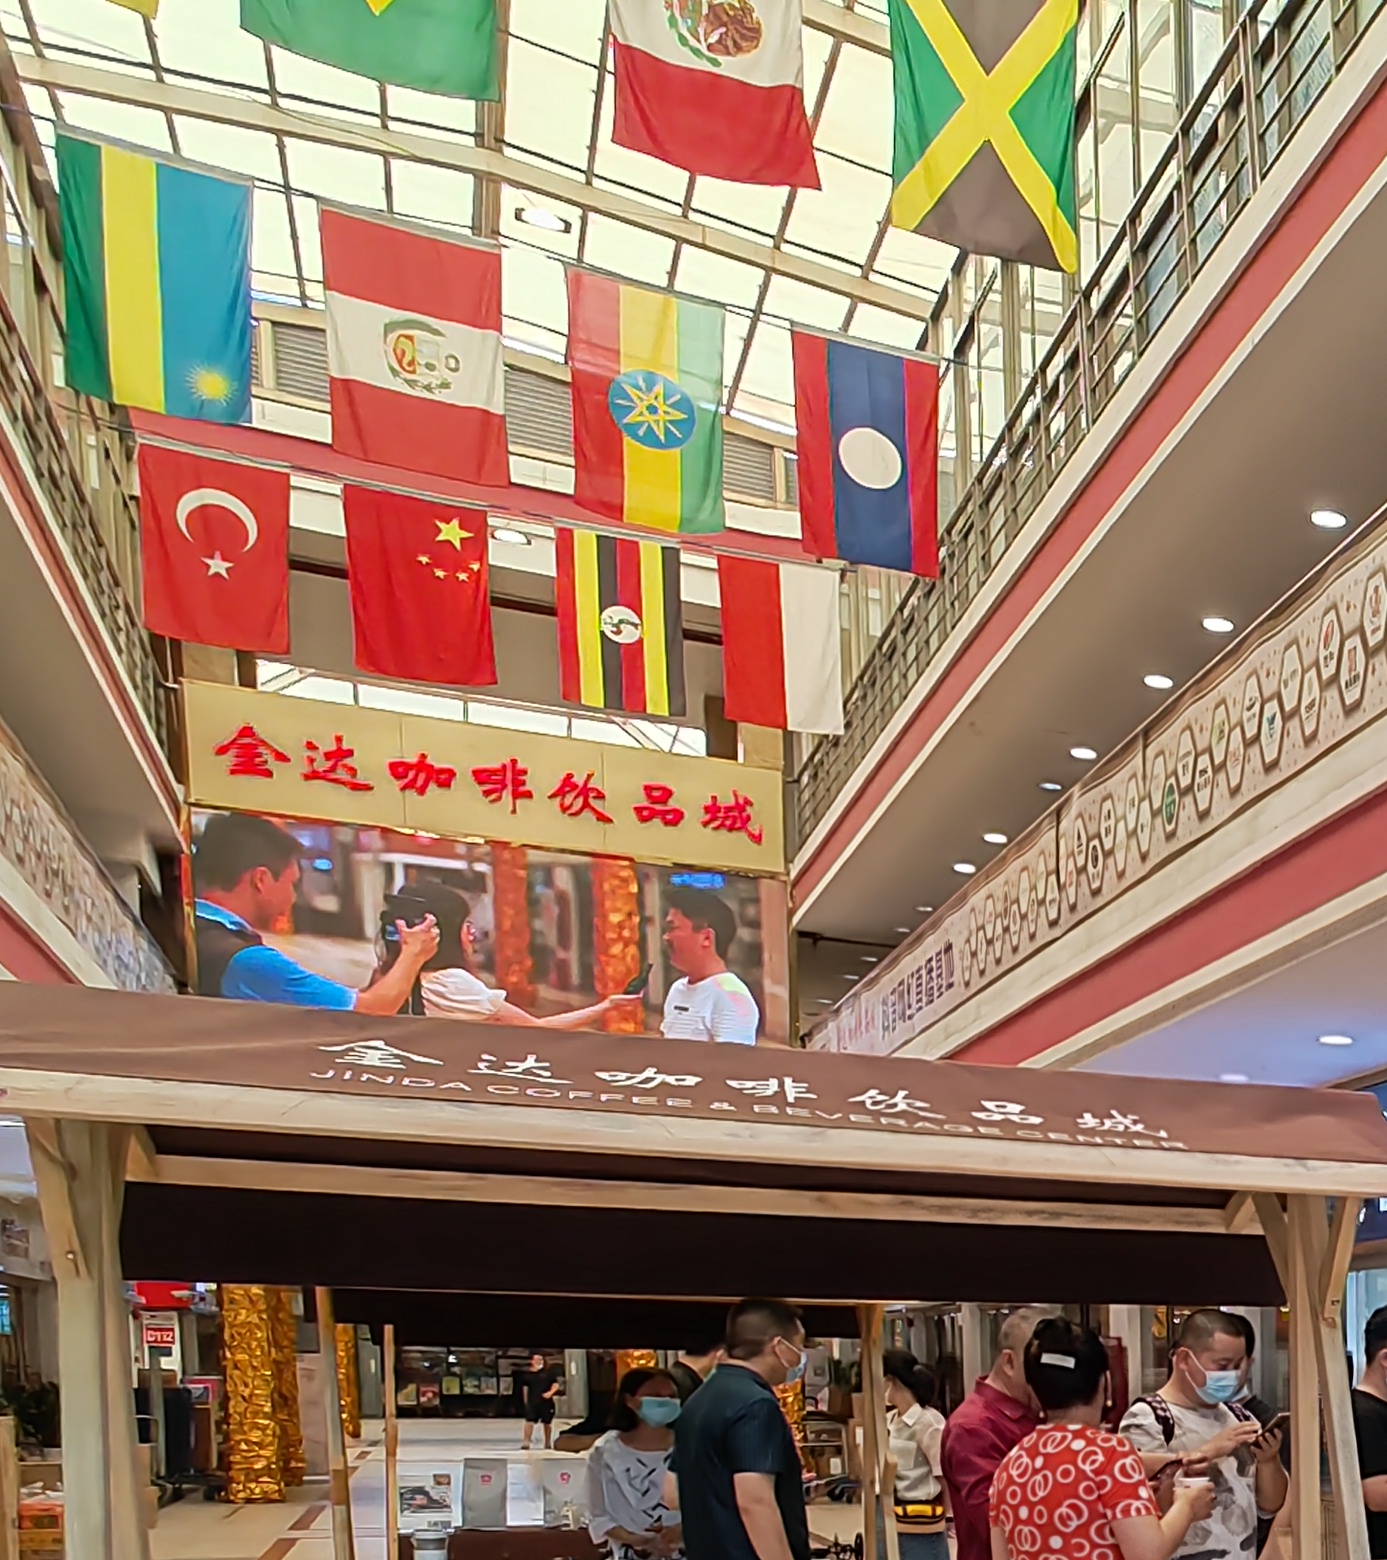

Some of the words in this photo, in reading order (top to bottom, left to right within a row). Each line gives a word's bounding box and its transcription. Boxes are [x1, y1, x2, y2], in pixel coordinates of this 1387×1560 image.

[214, 722, 764, 845] 金达咖啡饮品城
[309, 1067, 473, 1092] JINDA
[486, 1083, 693, 1110] COFFEE
[708, 1100, 738, 1112] &
[752, 1103, 1004, 1138] BEVERAGE
[1015, 1129, 1188, 1150] CENTER
[318, 1040, 1169, 1139] 金达咖啡饮品城
